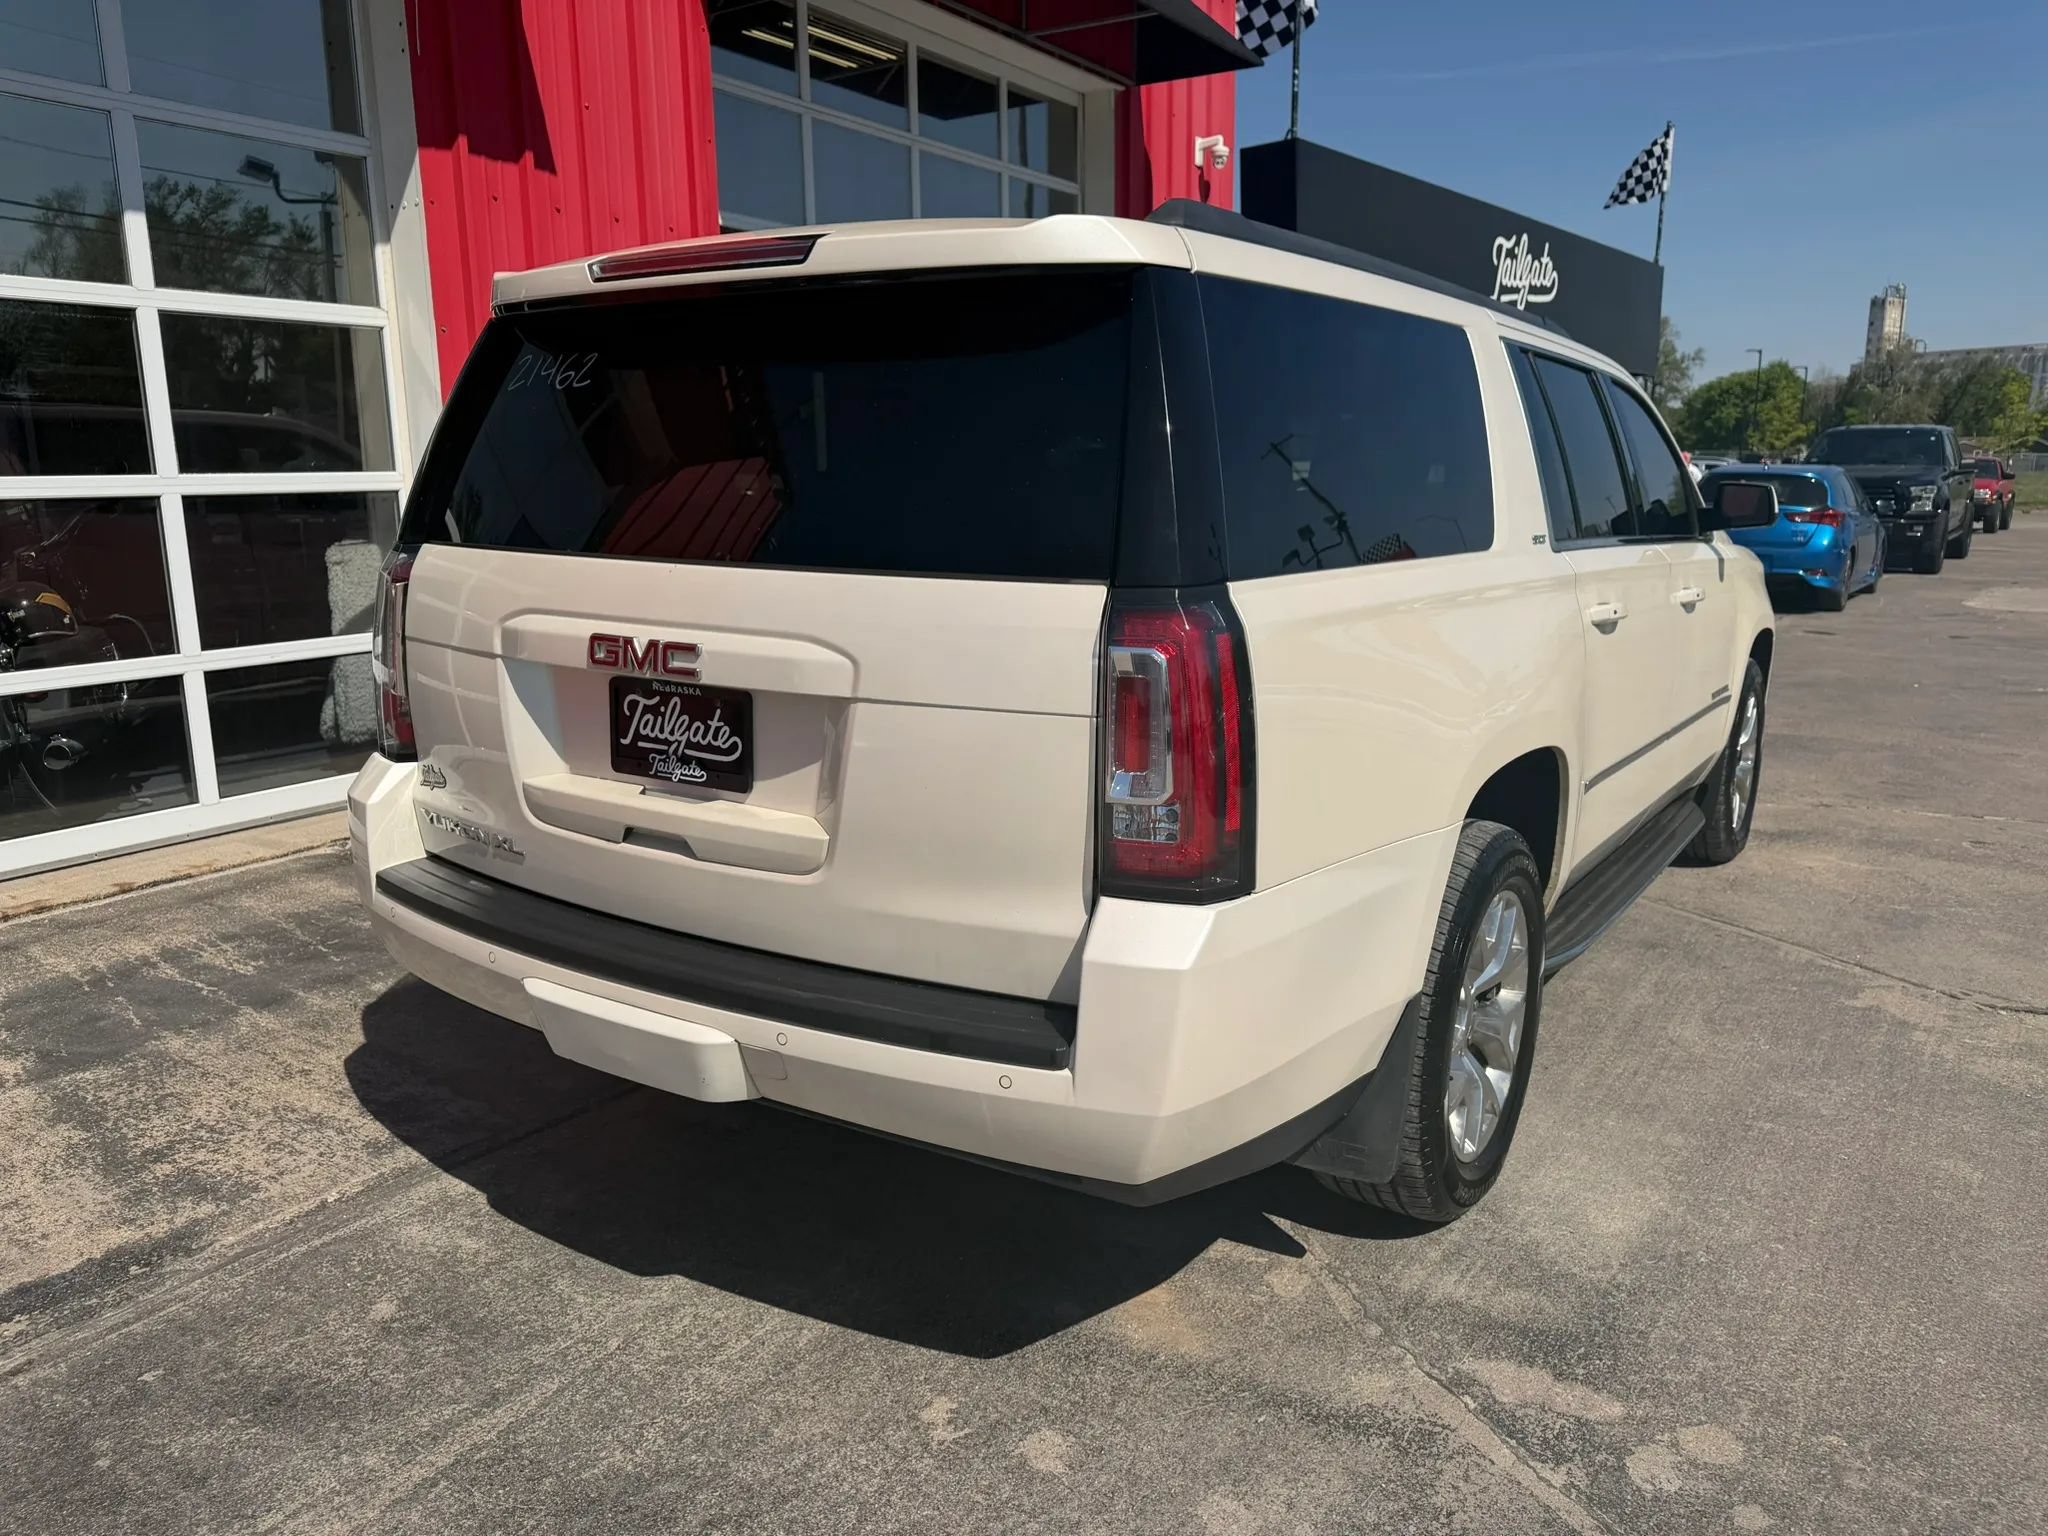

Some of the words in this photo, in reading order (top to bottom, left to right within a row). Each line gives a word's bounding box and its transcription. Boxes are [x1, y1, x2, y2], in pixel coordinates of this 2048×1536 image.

[1490, 232, 1559, 311] Tailgate
[507, 352, 598, 391] 21462
[589, 633, 704, 680] GMC
[620, 694, 743, 762] Tailgate
[649, 753, 707, 782] Tailgate
